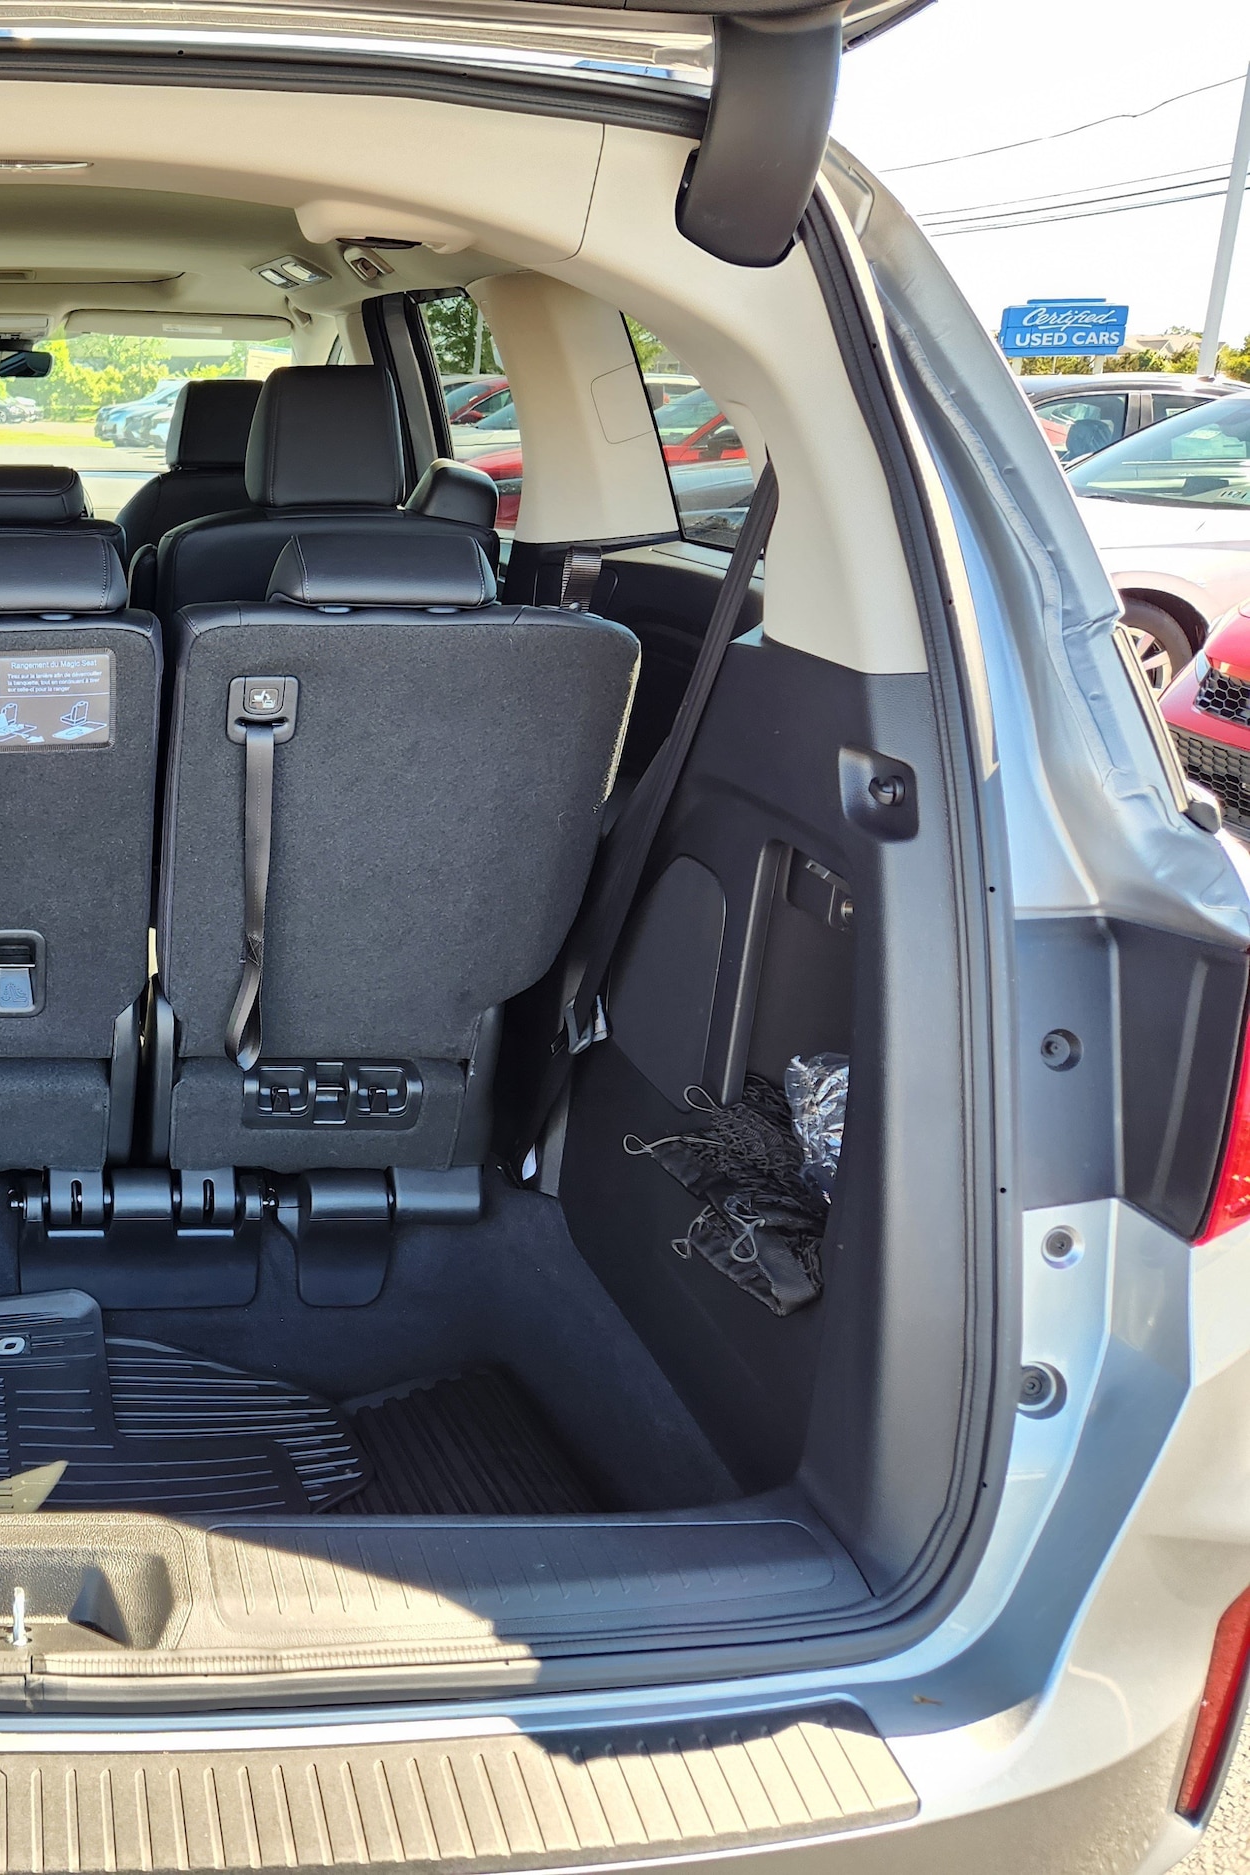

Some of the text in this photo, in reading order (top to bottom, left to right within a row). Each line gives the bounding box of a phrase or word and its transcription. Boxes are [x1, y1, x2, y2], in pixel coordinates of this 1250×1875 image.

[1022, 307, 1117, 331] Certified
[1015, 331, 1120, 347] USED CARS
[11, 662, 49, 670] Rangement
[60, 660, 80, 669] Magic
[81, 659, 97, 667] Seat
